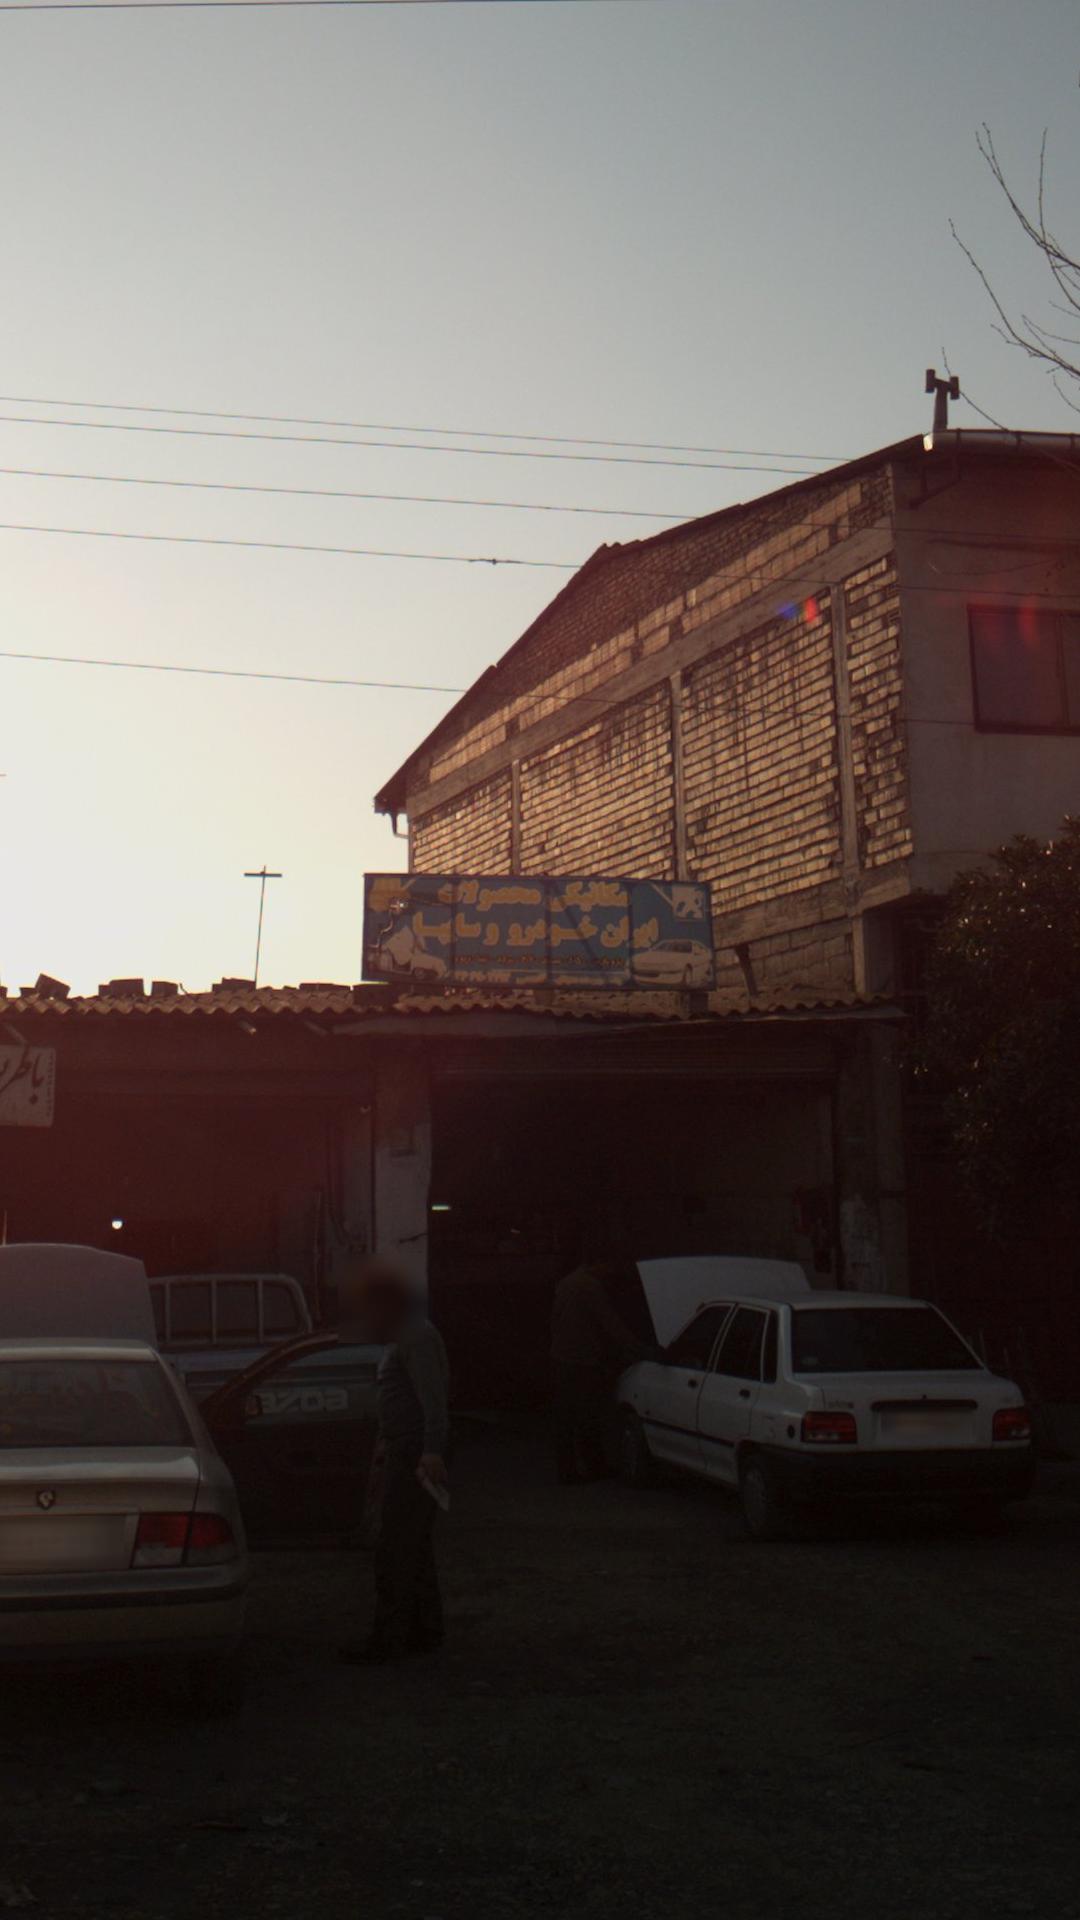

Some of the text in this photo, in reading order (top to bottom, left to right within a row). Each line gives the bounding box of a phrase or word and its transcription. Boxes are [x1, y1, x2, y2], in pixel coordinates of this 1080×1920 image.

[483, 922, 500, 946] و
[506, 915, 599, 946] خودرو
[600, 916, 659, 948] ایران
